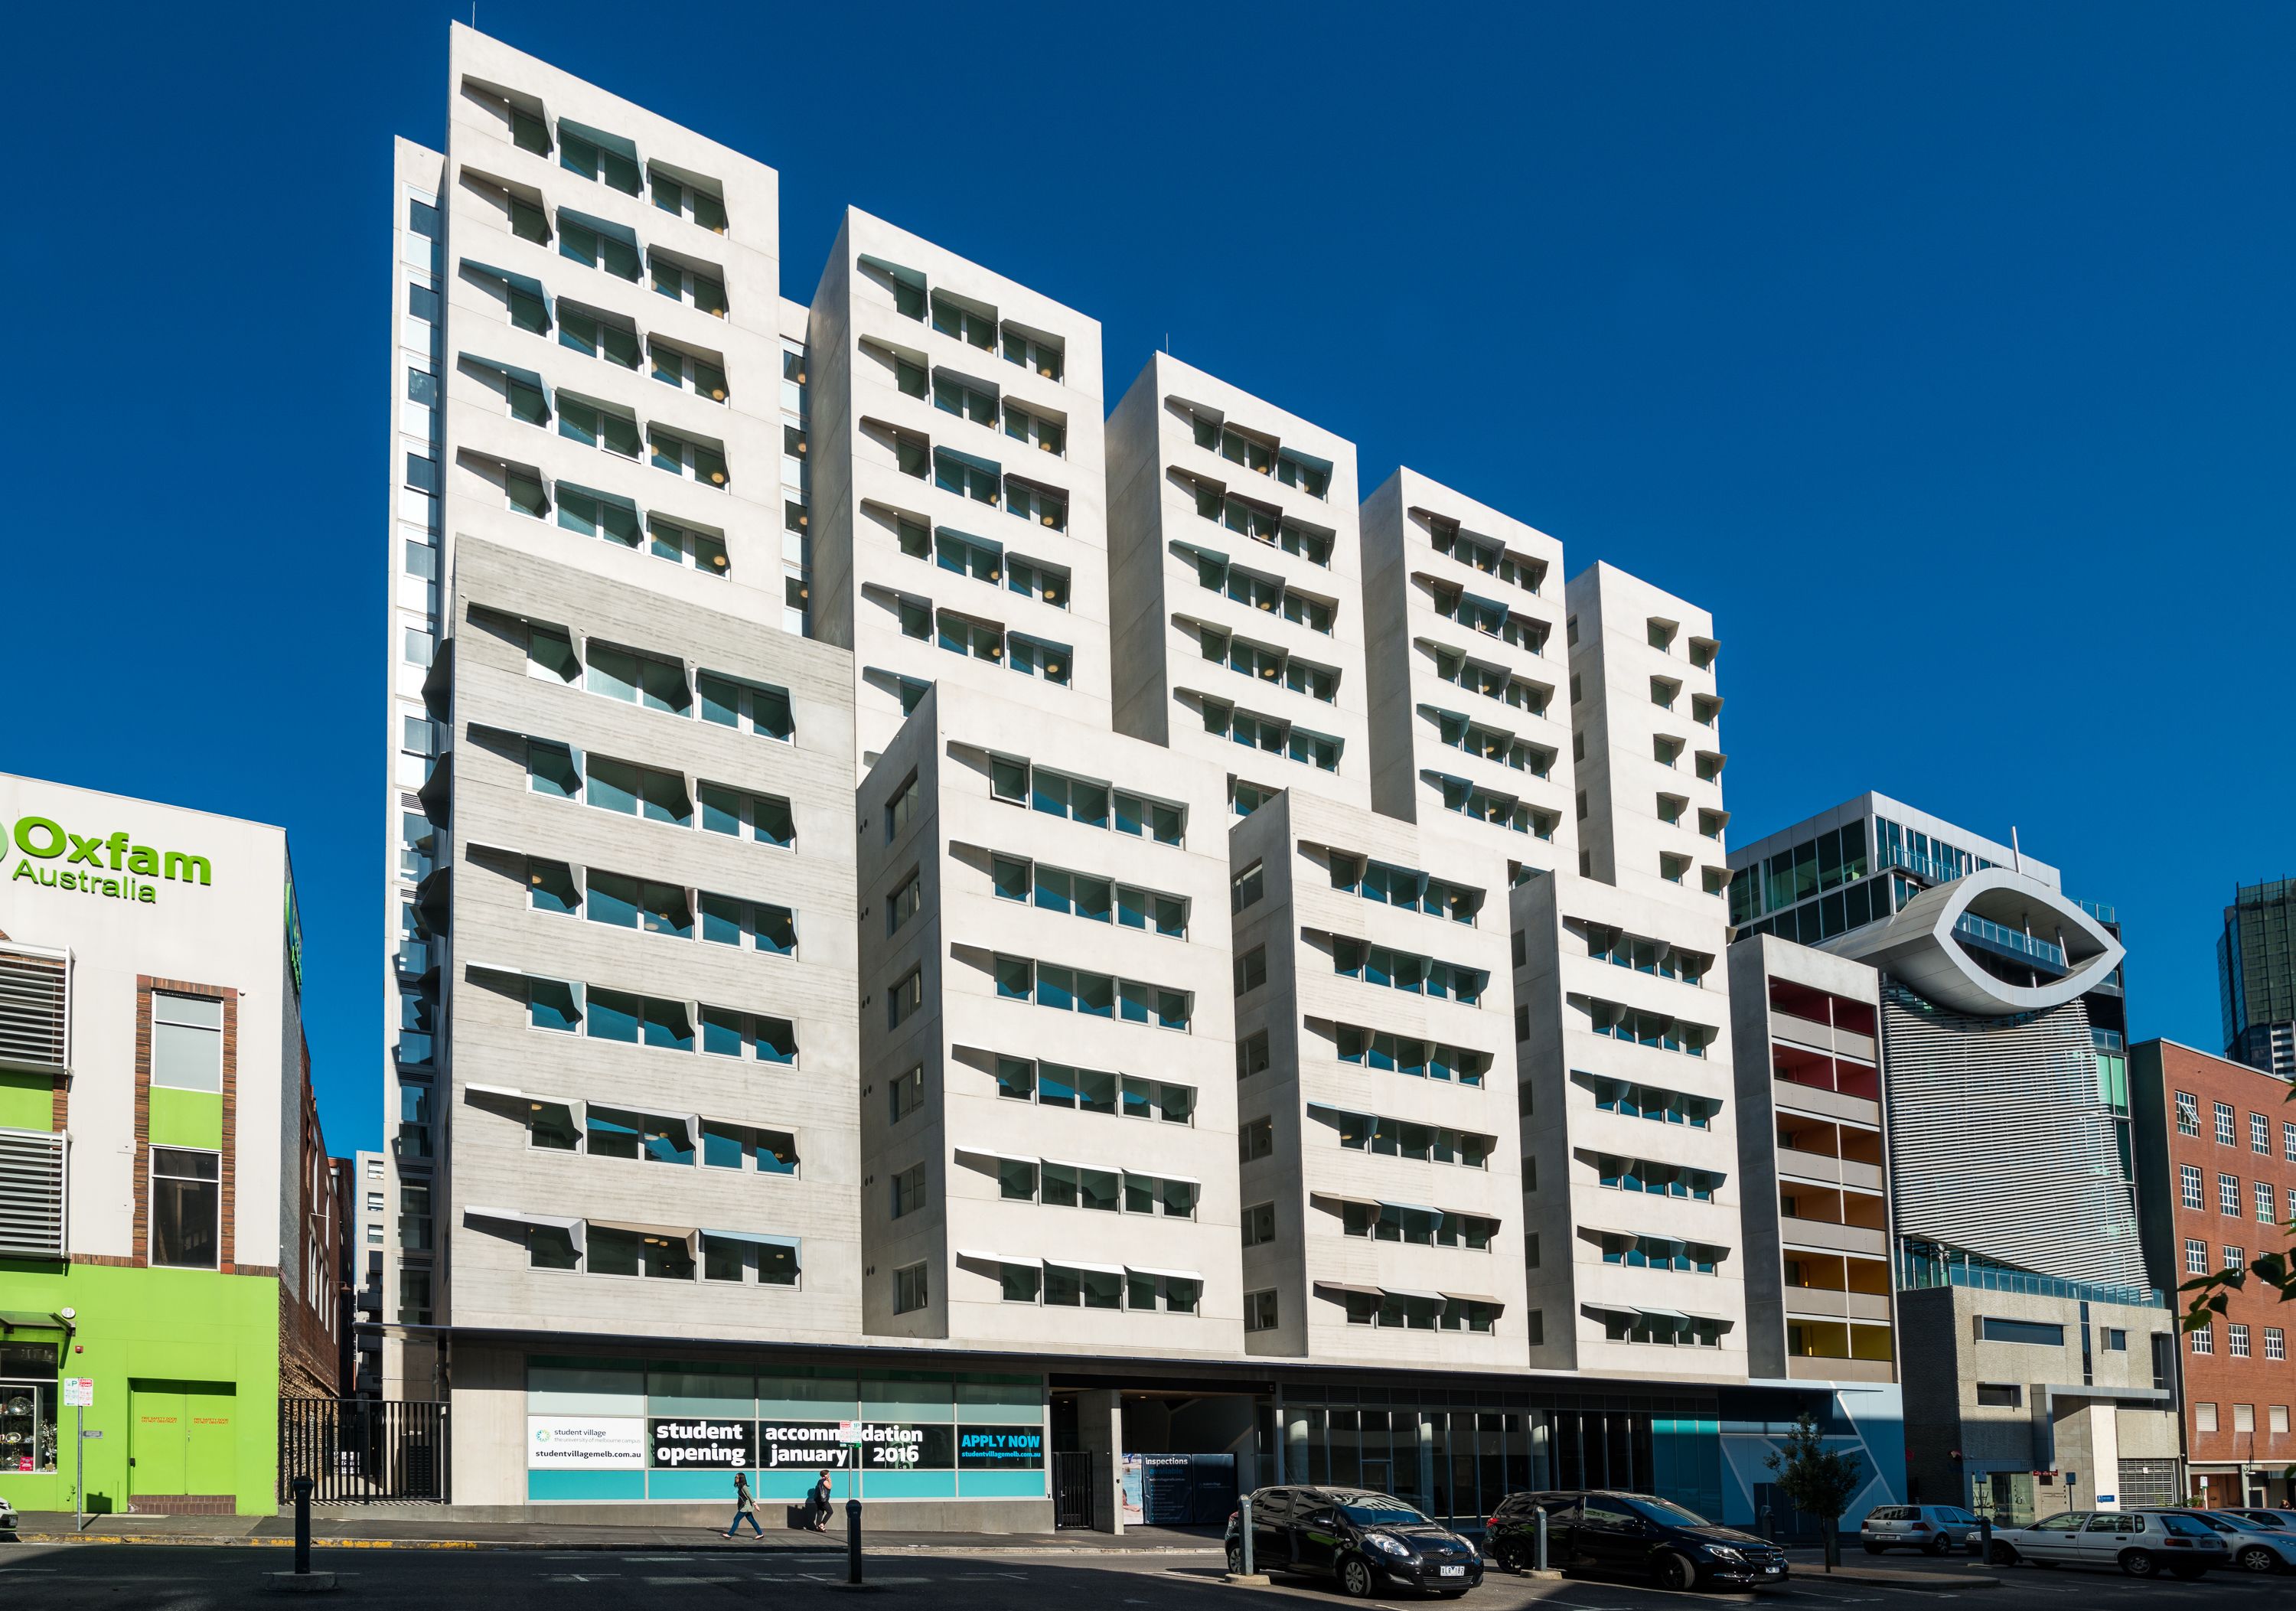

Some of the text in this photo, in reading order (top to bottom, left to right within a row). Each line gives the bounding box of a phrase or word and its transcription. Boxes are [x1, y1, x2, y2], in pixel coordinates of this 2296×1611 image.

[14, 816, 211, 886] Oxfam
[12, 859, 156, 904] Australia
[584, 1429, 606, 1437] village
[657, 1421, 743, 1440] student
[765, 1424, 923, 1442] accommdation
[961, 1435, 1040, 1447] APPLY NOW
[536, 1450, 641, 1459] studentvillagemelb.com.au
[657, 1443, 919, 1467] opening january 2016
[1145, 1457, 1188, 1466] inspections
